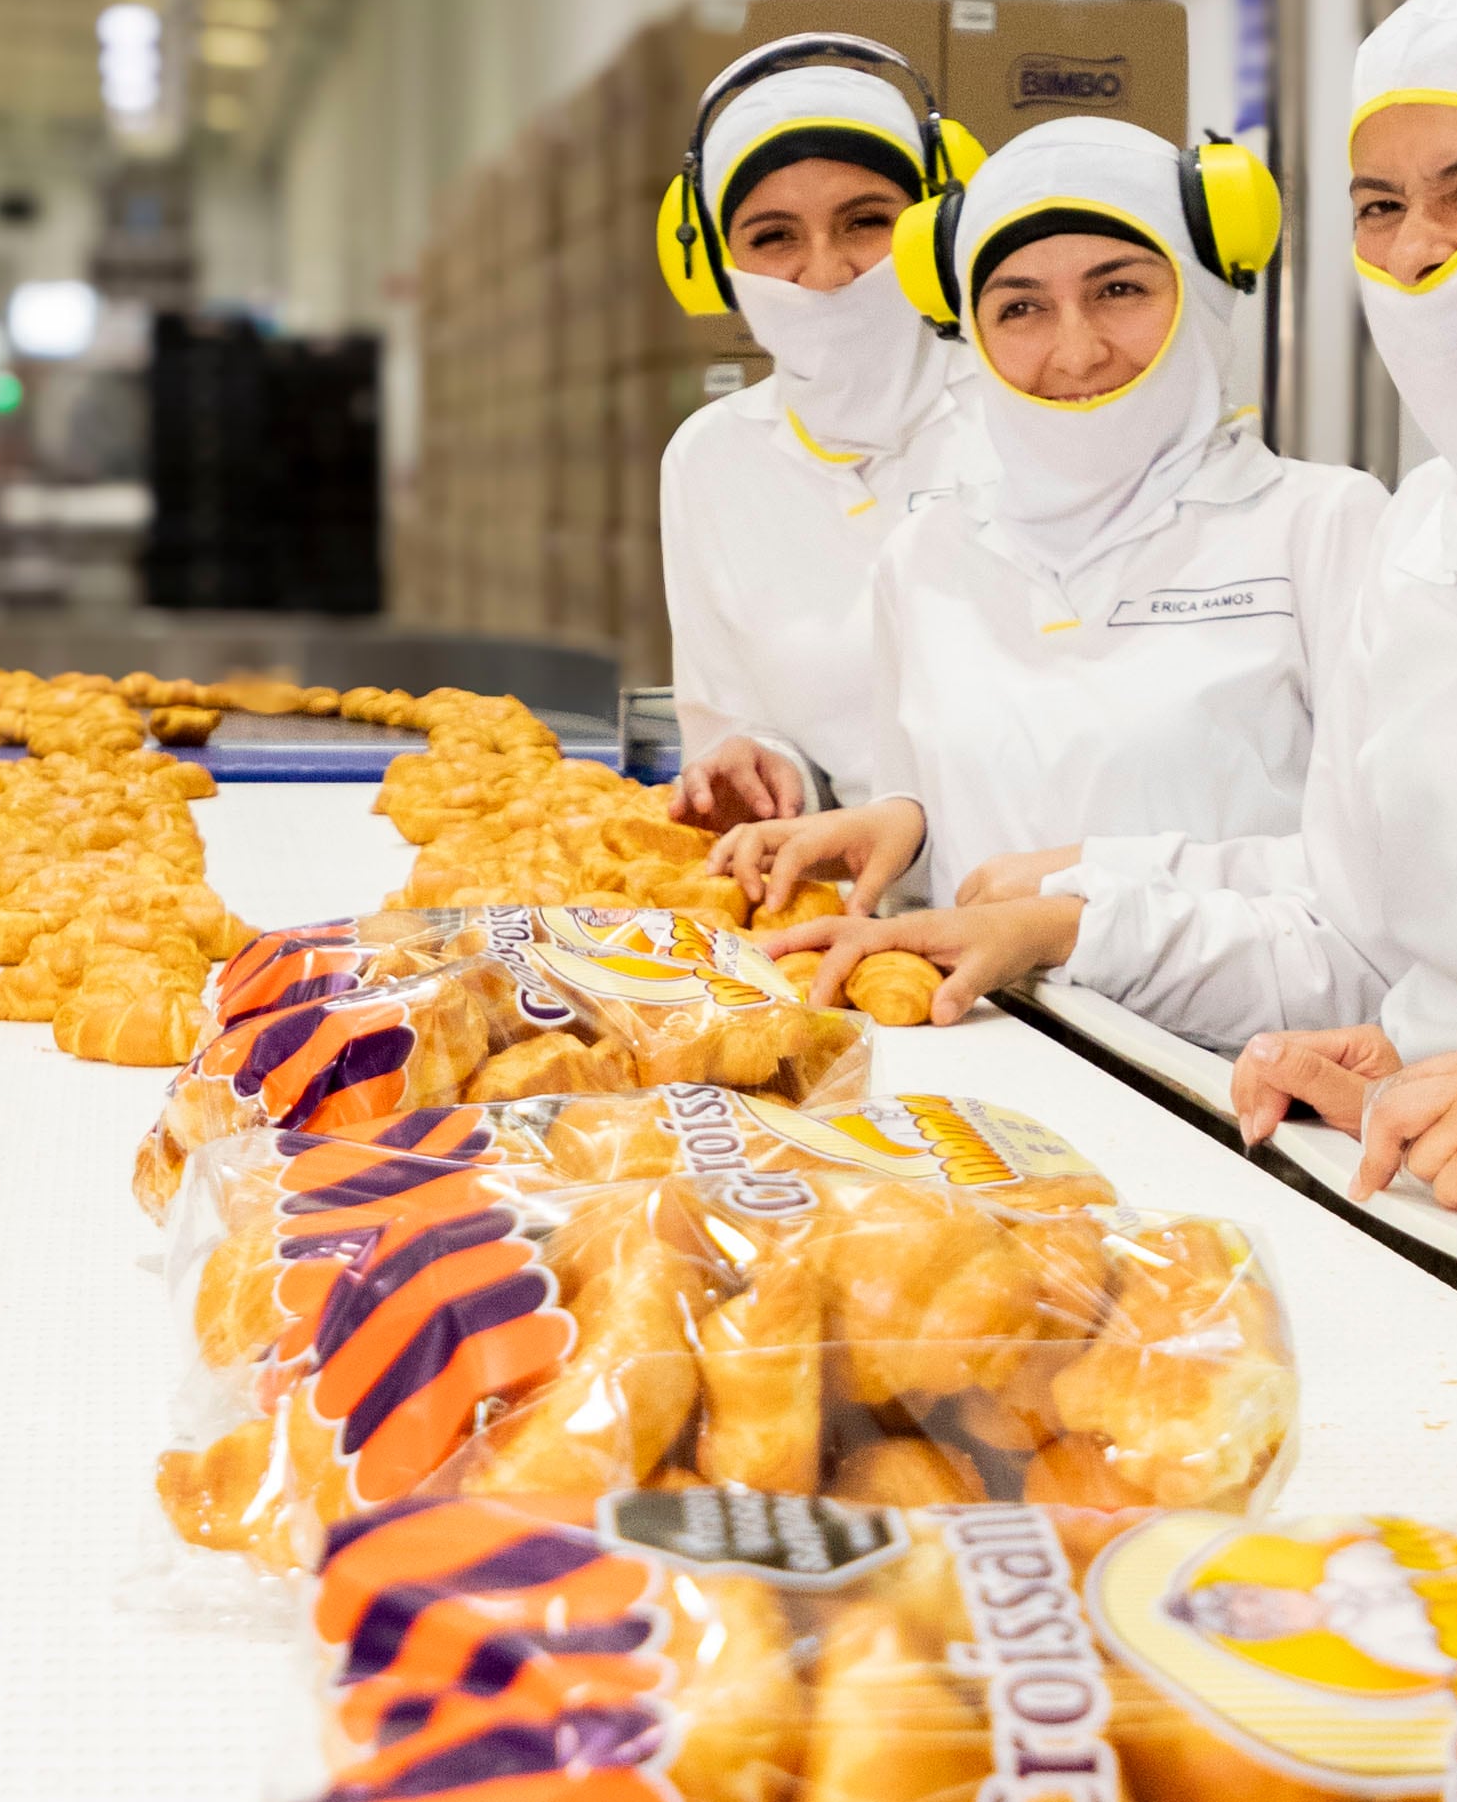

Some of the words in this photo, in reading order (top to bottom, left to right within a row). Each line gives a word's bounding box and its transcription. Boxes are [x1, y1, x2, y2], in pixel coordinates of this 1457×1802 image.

[1020, 70, 1121, 97] BIMBO
[1150, 599, 1197, 614] ERICA
[1201, 591, 1254, 609] RAMOS
